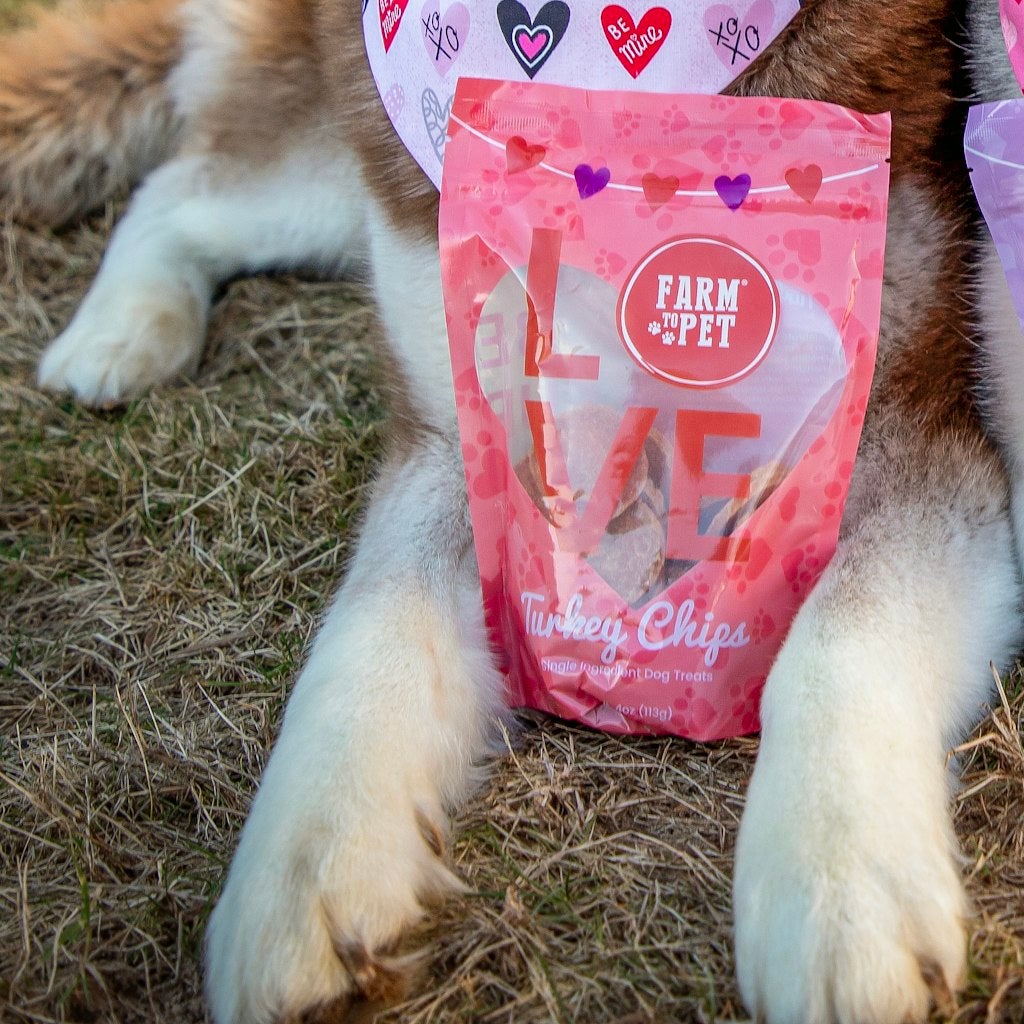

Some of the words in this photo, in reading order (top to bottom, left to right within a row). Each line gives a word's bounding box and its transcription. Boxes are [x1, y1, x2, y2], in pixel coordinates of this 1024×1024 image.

[608, 17, 630, 40] BE
[656, 274, 741, 312] FARM
[662, 312, 679, 329] TO
[677, 312, 736, 349] PET
[520, 591, 629, 664] Turkey
[637, 598, 750, 667] Chips
[541, 657, 577, 673] Single
[580, 660, 641, 679] Ingredient
[644, 667, 670, 684] Dog
[673, 669, 713, 682] Treats
[639, 703, 673, 721] (113g)
